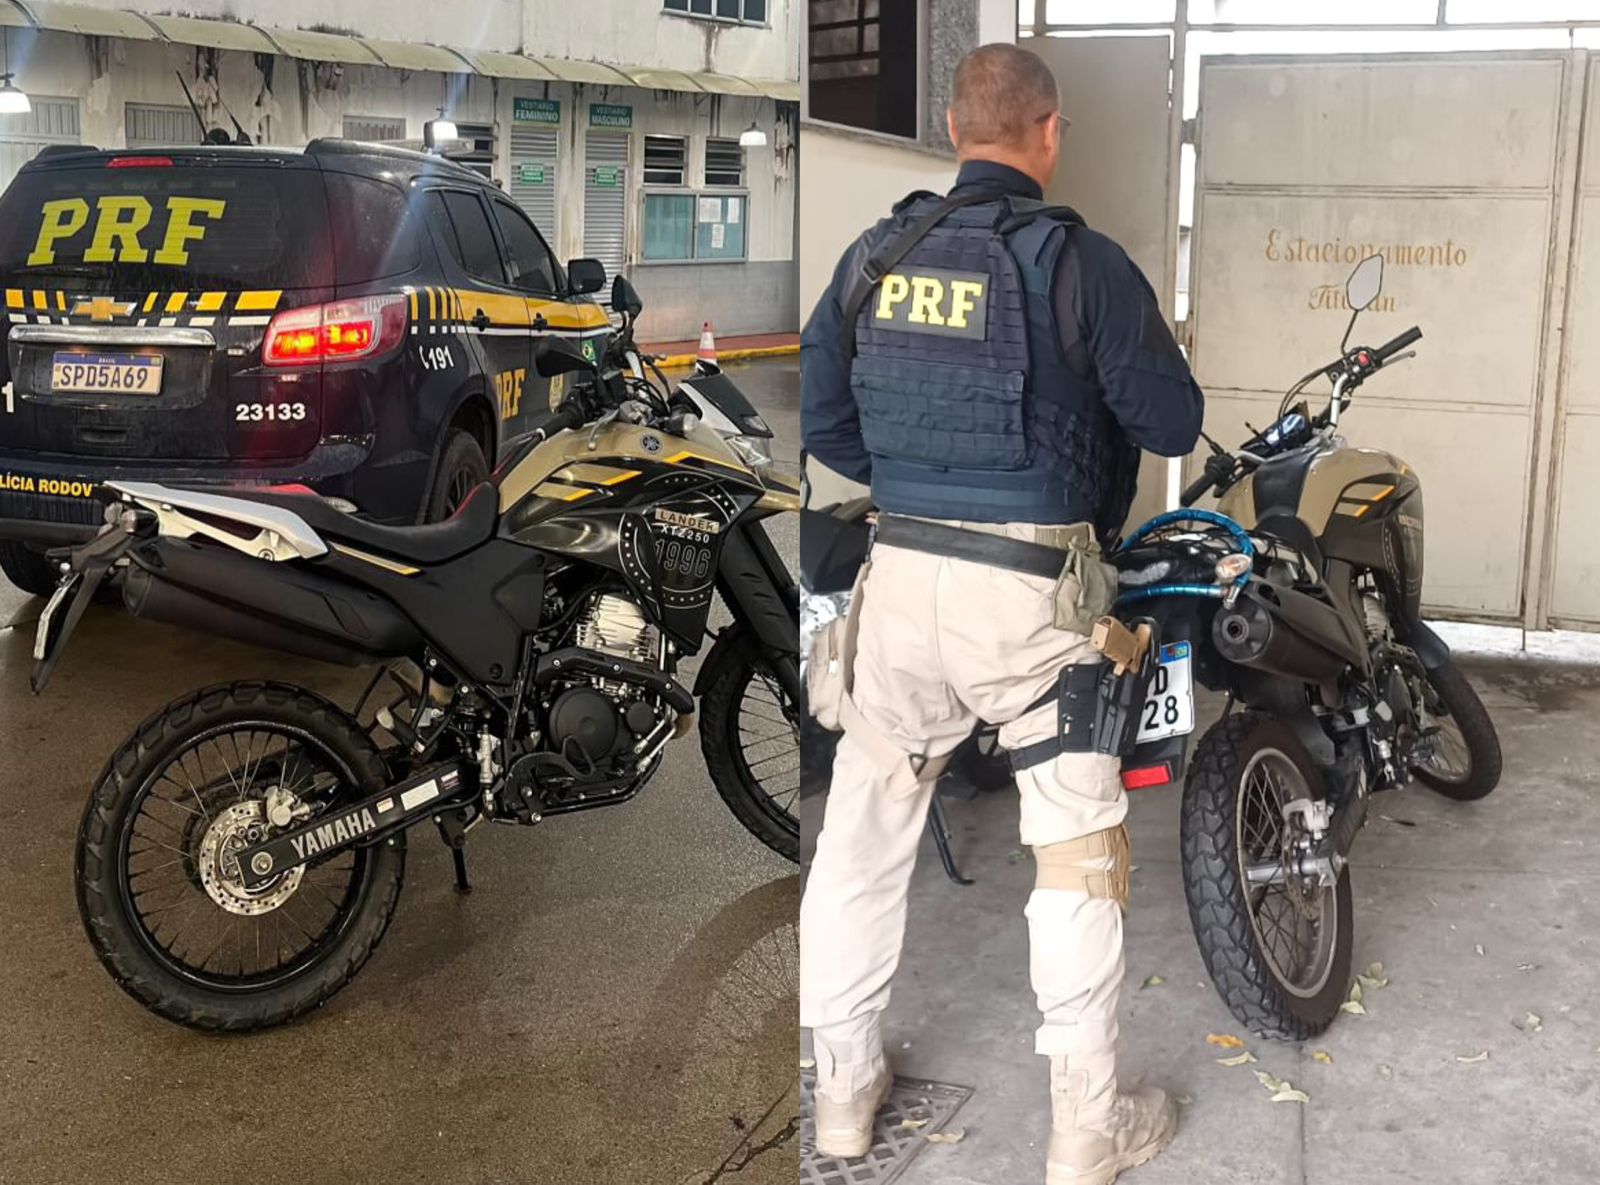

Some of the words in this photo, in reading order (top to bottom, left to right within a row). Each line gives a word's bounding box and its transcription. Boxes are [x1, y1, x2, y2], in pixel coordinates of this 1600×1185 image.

[515, 109, 559, 122] FEMININO
[591, 114, 630, 126] MASCULINO
[27, 196, 226, 267] PRF
[1265, 229, 1467, 267] Estacionamento
[875, 274, 983, 328] PRF
[428, 344, 454, 371] 191
[60, 365, 149, 389] SPD5A69
[235, 402, 306, 421] 23133
[38, 479, 93, 497] RODOV
[660, 510, 714, 532] LANDER
[661, 524, 710, 543] XTZ250
[655, 539, 712, 578] 1996
[290, 808, 377, 860] YAMAHA
